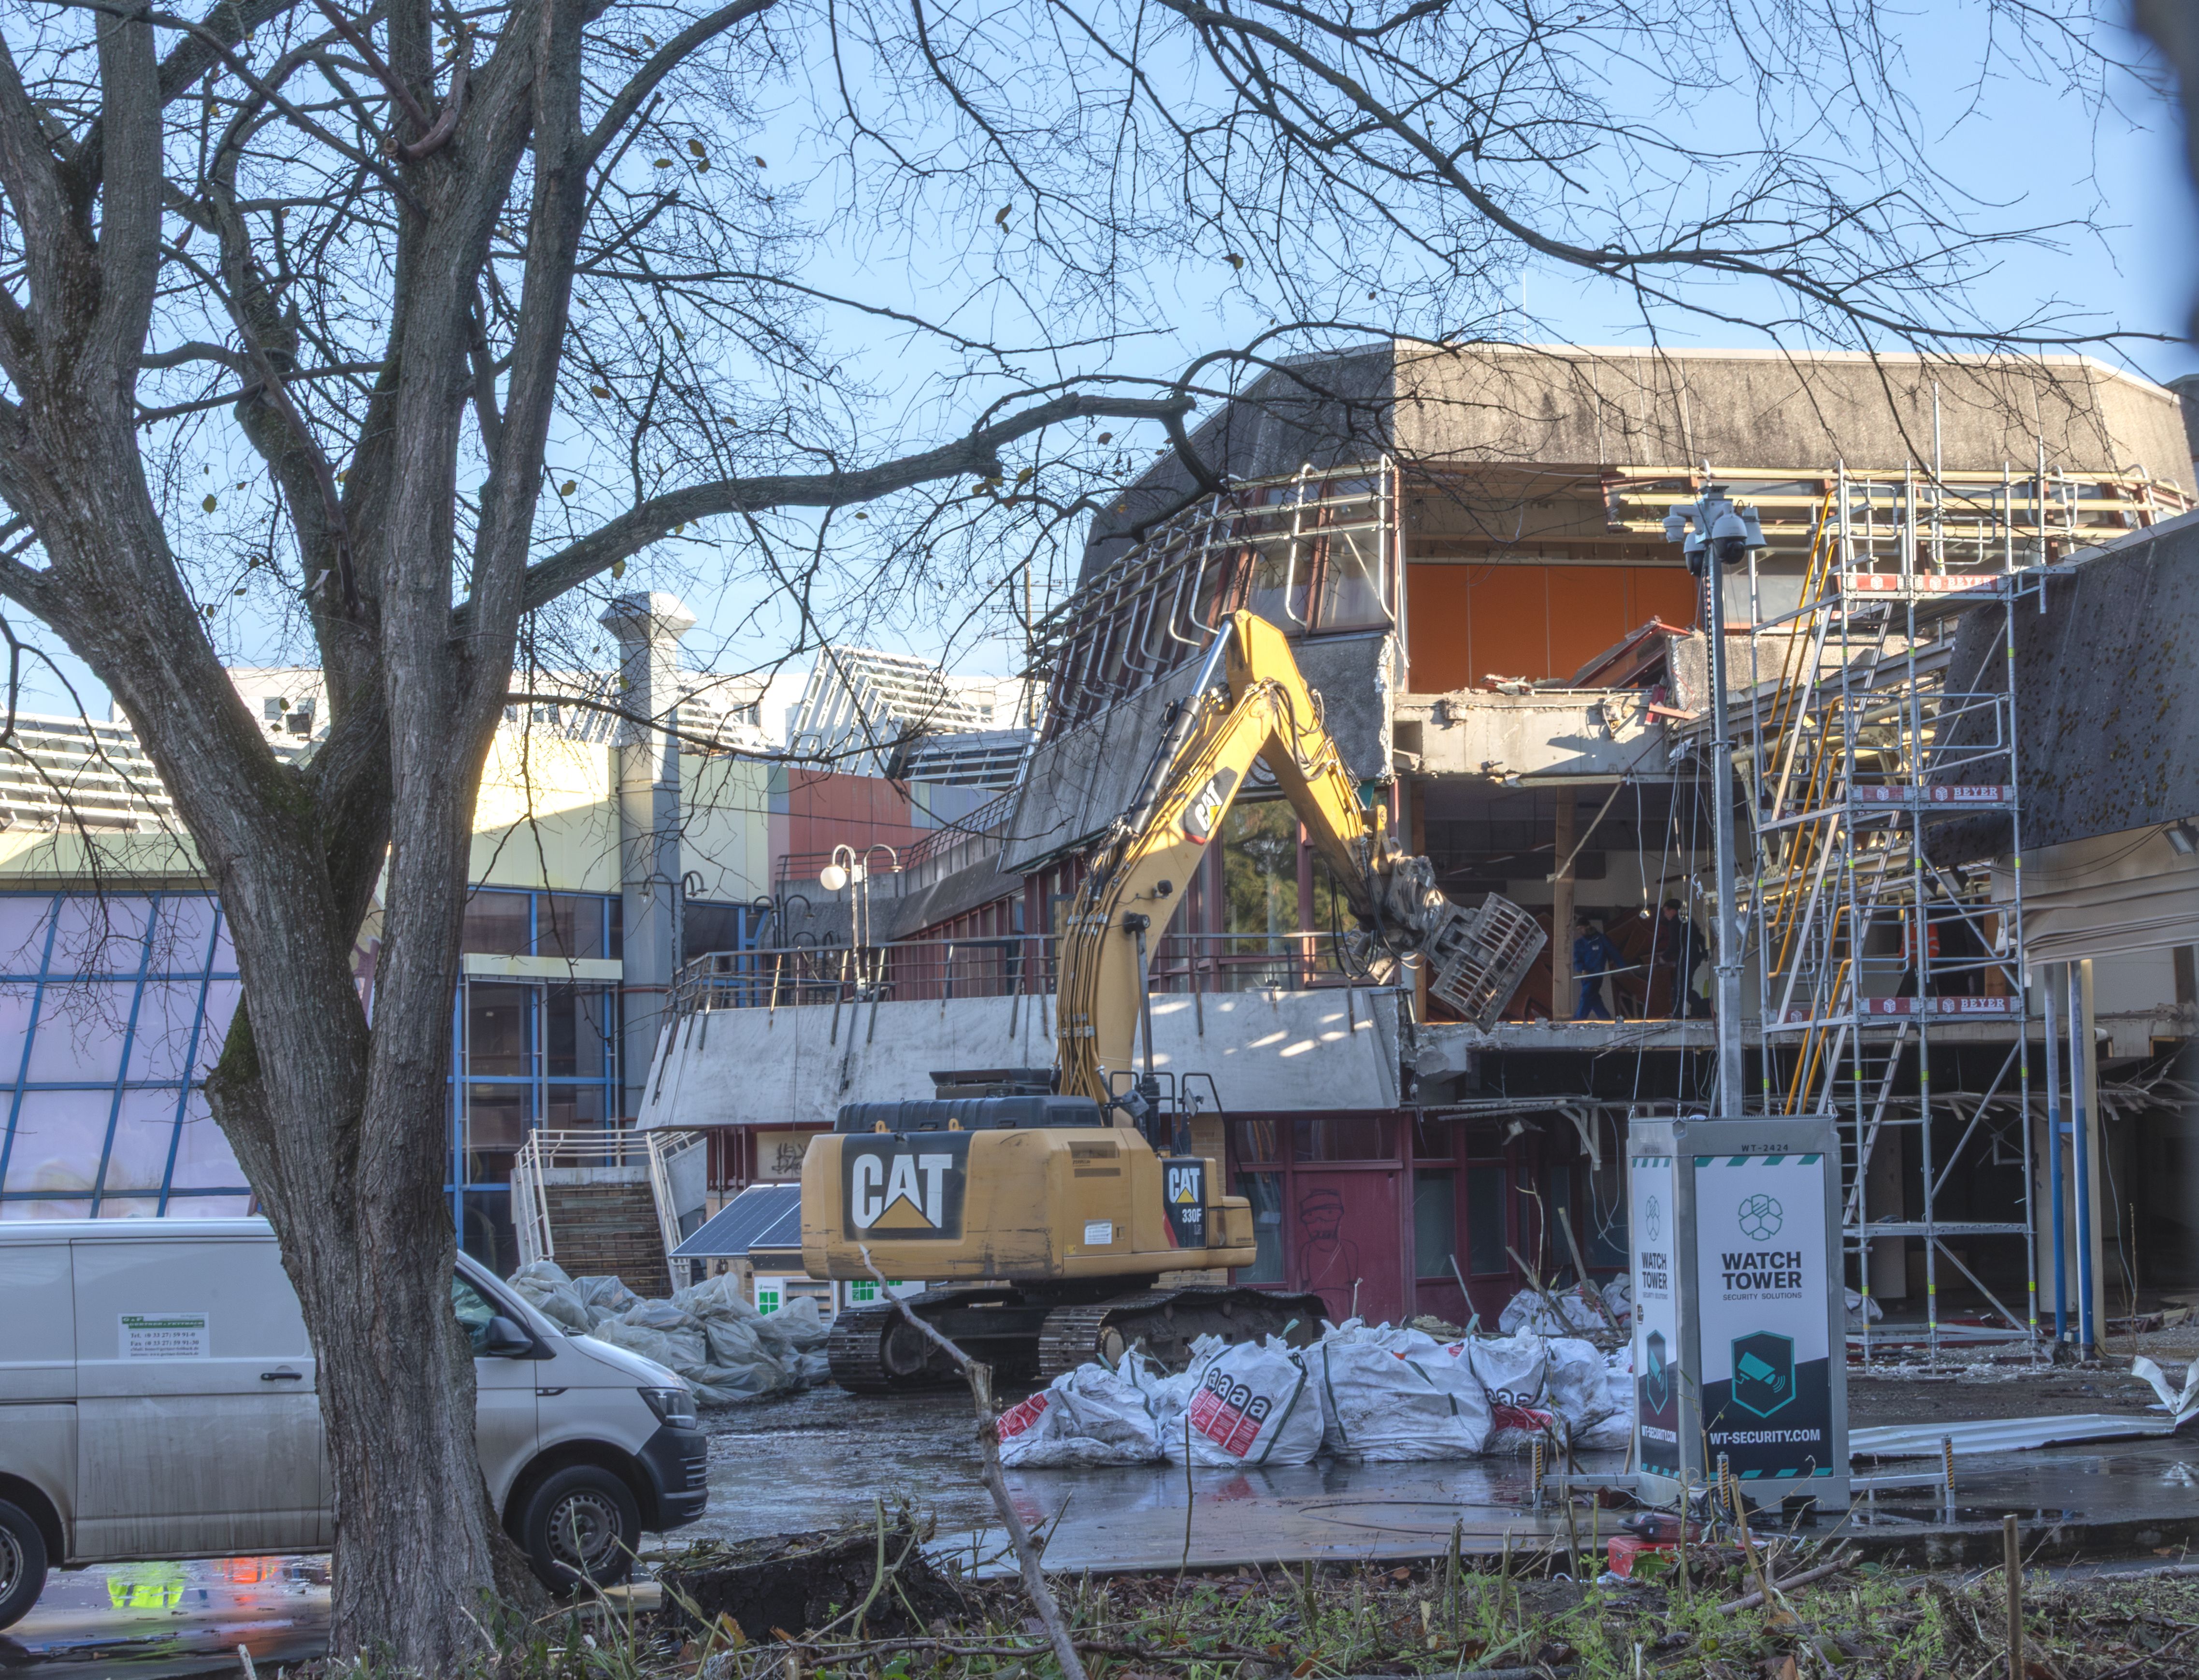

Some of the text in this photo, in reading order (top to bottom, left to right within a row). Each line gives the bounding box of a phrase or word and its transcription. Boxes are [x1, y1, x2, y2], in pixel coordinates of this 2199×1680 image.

[1947, 577, 1991, 586] BEYER
[1954, 787, 1998, 796] BEYER
[1195, 780, 1223, 832] CAT
[1961, 999, 2005, 1007] BEYER
[1741, 1144, 1789, 1152] WT-2424
[852, 1154, 953, 1229] CAT
[1168, 1167, 1200, 1203] CAT
[1182, 1208, 1202, 1223] 330F
[1641, 1252, 1667, 1270] WATCH
[1722, 1251, 1802, 1270] WATCH
[1642, 1271, 1667, 1290] TOWER
[1722, 1271, 1802, 1290] TOWER
[1723, 1292, 1802, 1301] SECURITY SOLUTIONS
[1710, 1429, 1821, 1446] WT-SECURITY.COM
